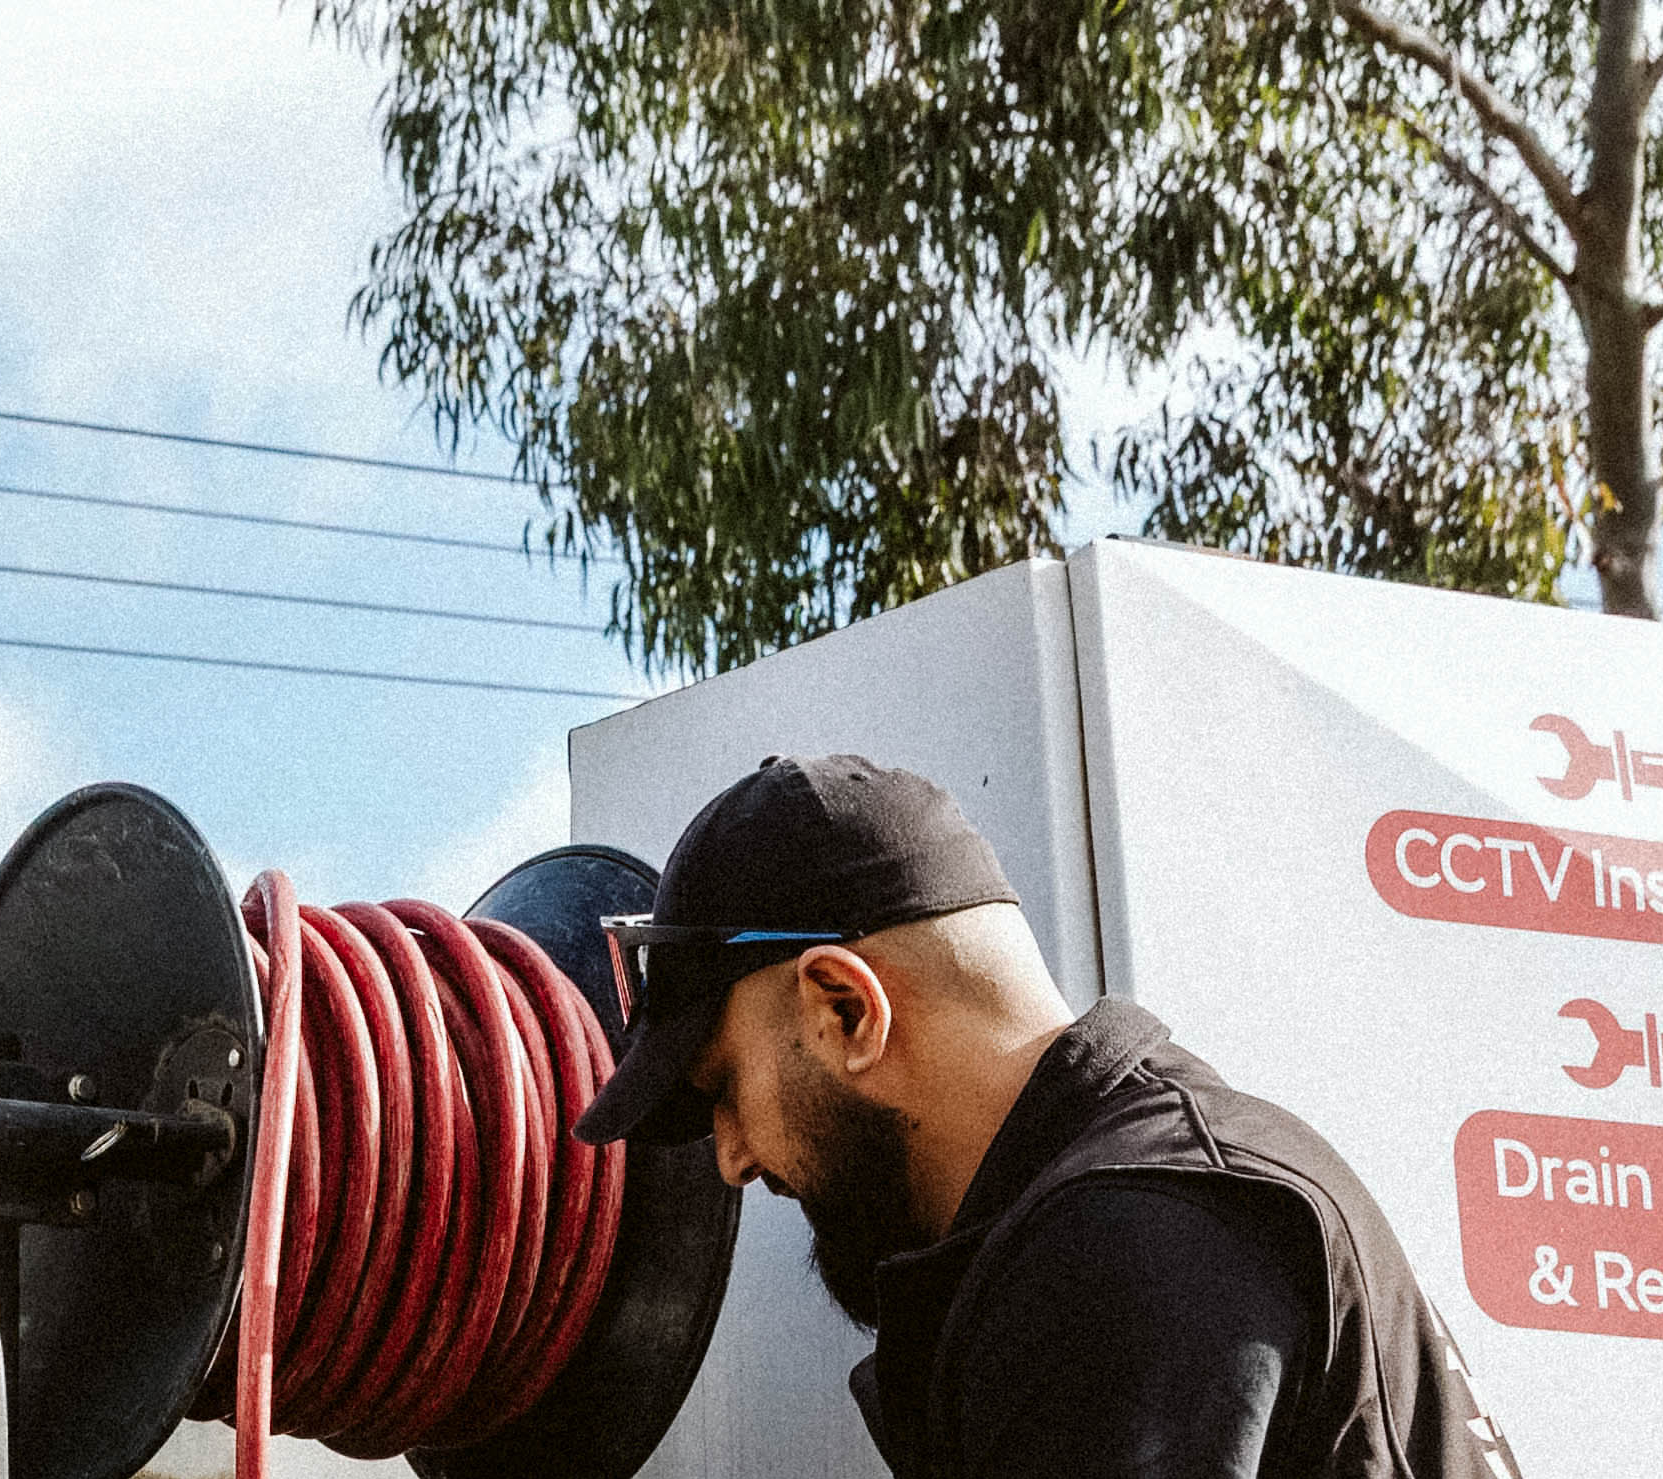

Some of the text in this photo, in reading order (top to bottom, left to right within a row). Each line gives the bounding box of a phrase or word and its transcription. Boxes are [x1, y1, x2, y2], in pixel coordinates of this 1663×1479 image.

[1394, 828, 1574, 903] CCTV
[1492, 1138, 1651, 1210] Drain
[1529, 1245, 1578, 1305] &
